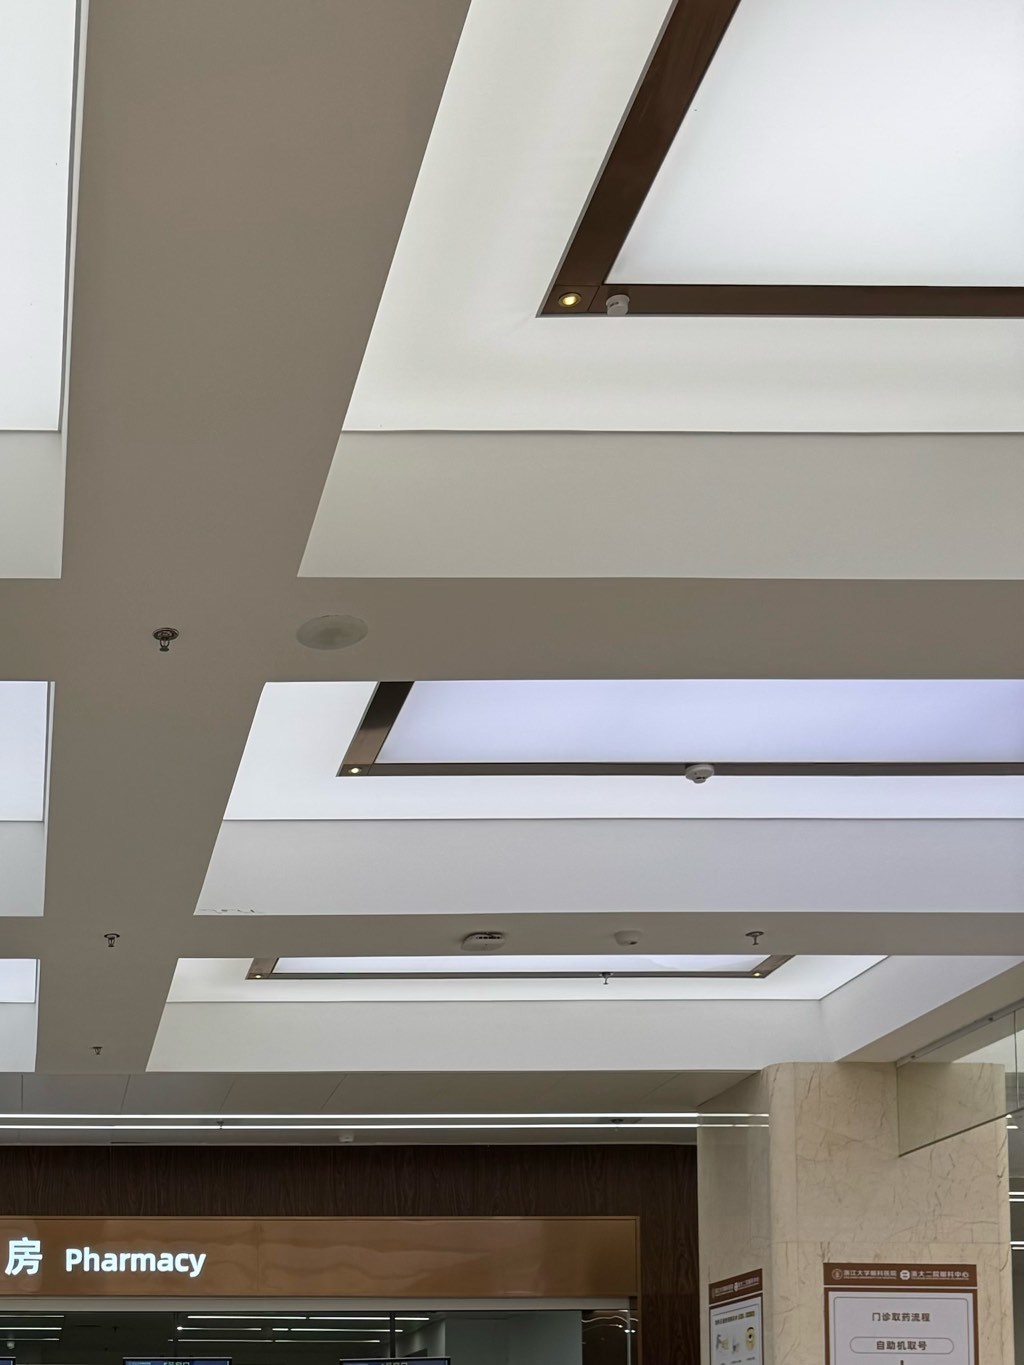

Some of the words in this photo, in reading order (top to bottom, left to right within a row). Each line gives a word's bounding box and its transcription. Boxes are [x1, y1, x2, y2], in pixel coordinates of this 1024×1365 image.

[65, 1247, 207, 1277] Pharmacy
[871, 1312, 931, 1322] 门诊取药流程
[876, 1340, 927, 1351] 自助机取号
